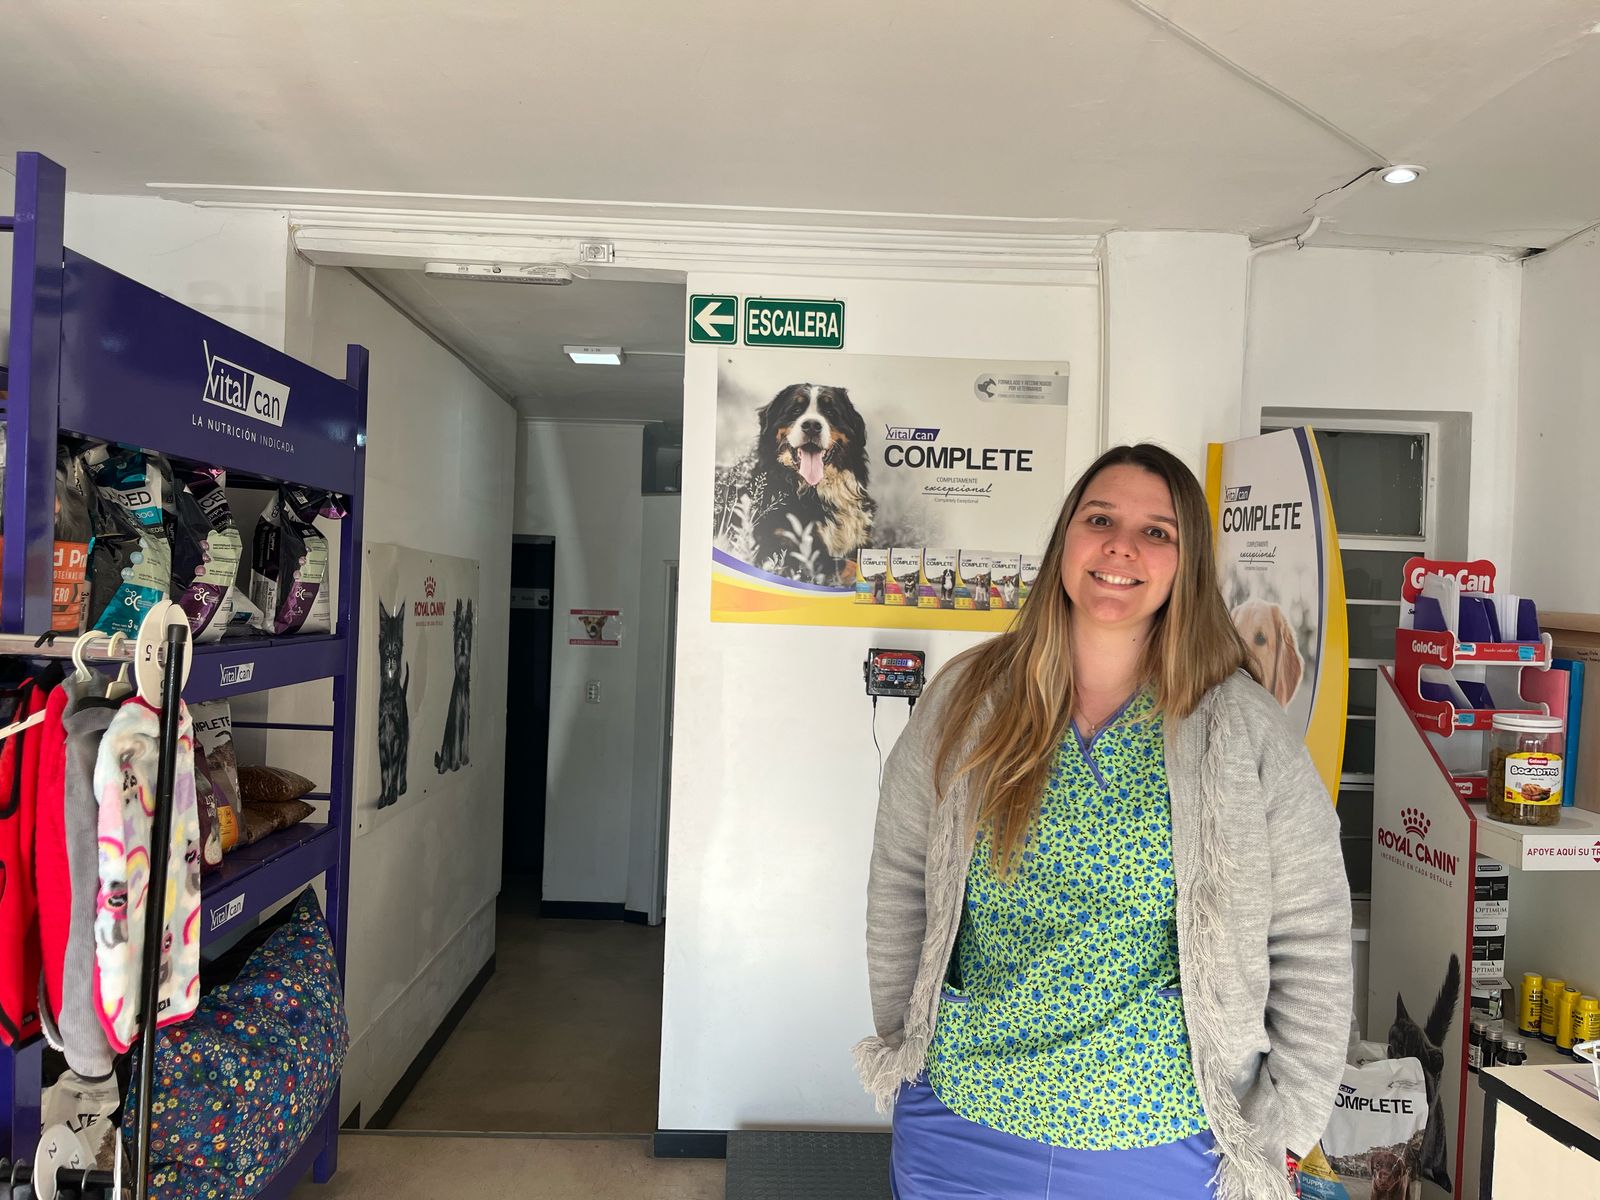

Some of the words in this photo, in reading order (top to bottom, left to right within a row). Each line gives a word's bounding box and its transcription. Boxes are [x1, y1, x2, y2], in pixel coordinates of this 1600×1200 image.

[749, 309, 839, 338] ESCALERA
[192, 414, 203, 427] LA
[207, 419, 256, 443] NUTRICIÓN
[260, 434, 295, 454] INDICADA
[884, 444, 1033, 472] COMPLETE
[936, 476, 978, 484] COMPLETAMENTE
[924, 483, 993, 497] excepcional
[1223, 502, 1303, 533] COMPLETE
[414, 601, 430, 616] ROYAL
[128, 619, 133, 629] 3
[192, 716, 230, 733] MPLETE
[1511, 765, 1559, 776] BOCADITOS
[1378, 827, 1413, 858] ROYAL
[1415, 843, 1456, 876] CANIN
[1527, 848, 1555, 856] APOYE
[1556, 846, 1577, 856] AQUÍ
[1578, 848, 1590, 856] SU
[1429, 872, 1453, 888] DETALLE
[1334, 1092, 1414, 1115] OMPLETE
